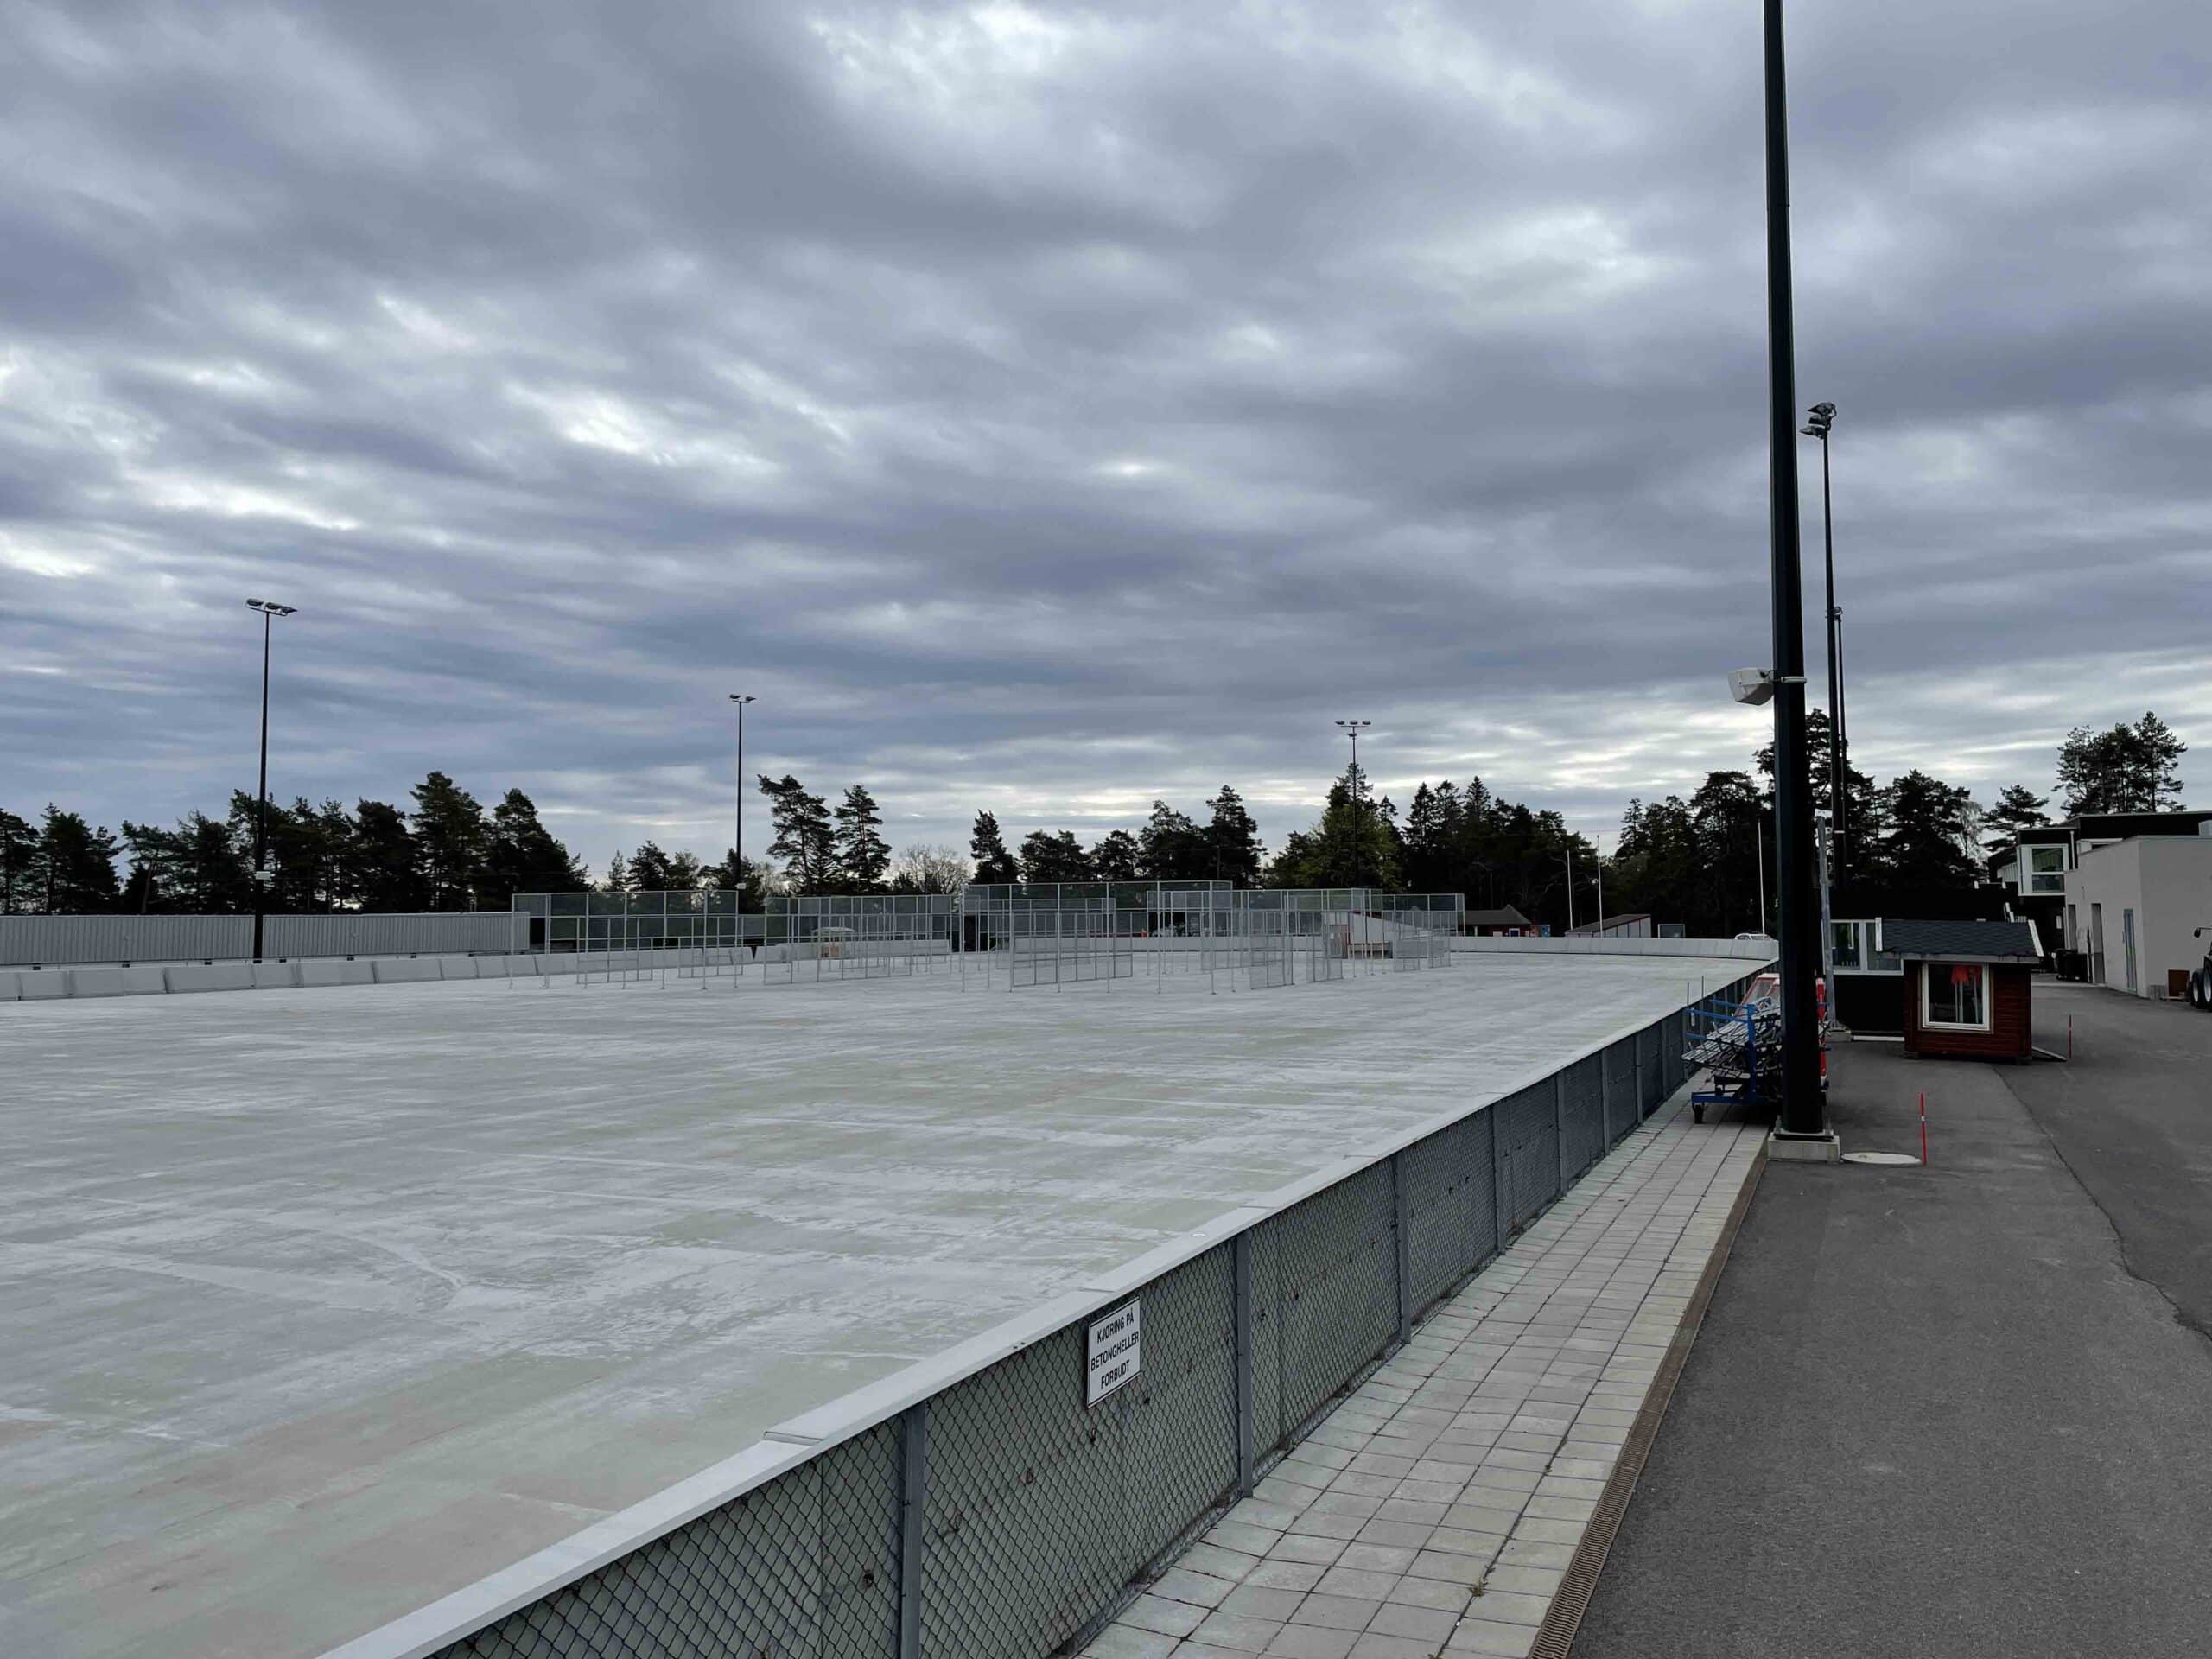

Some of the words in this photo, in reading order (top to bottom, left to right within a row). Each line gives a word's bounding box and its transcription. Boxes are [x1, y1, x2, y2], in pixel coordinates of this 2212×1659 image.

[1126, 1307, 1134, 1326] PÅ
[1090, 1331, 1139, 1372] BETONGHELLER
[1100, 1359, 1130, 1389] FORBUDT
